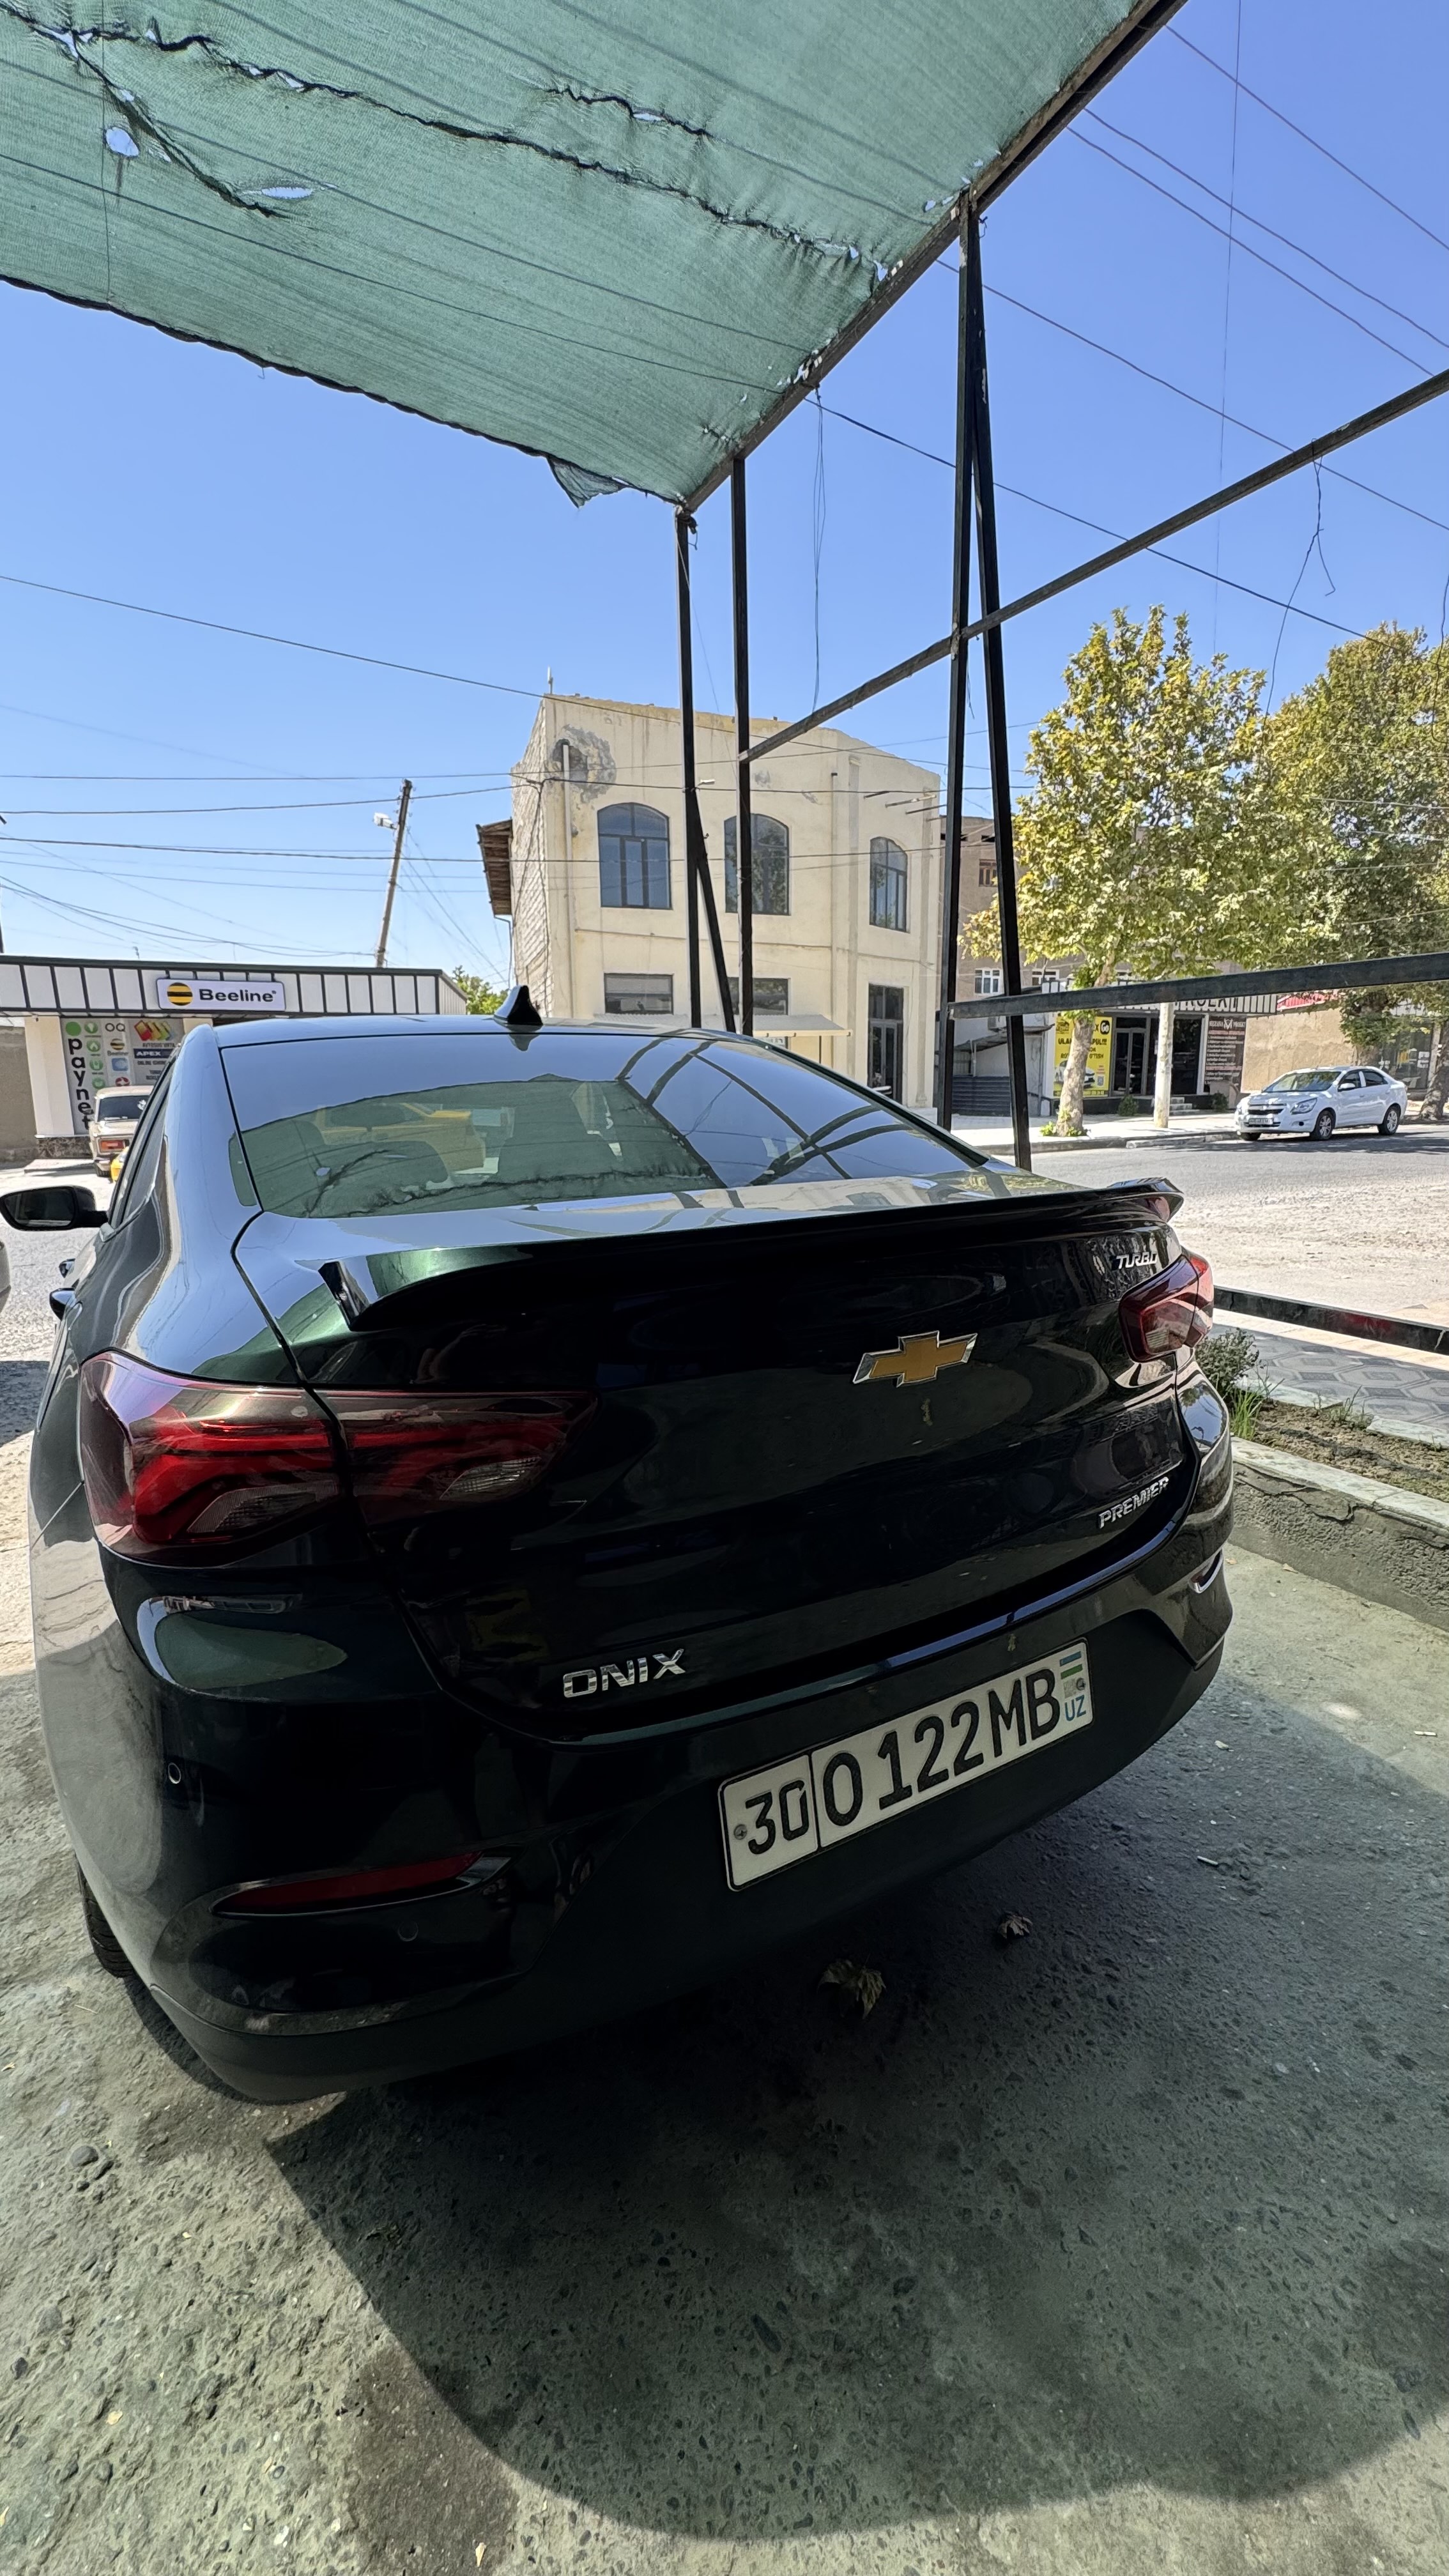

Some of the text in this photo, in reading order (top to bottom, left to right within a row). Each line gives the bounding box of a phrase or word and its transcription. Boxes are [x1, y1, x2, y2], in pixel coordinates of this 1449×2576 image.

[199, 988, 273, 1002] Beeline
[105, 1022, 126, 1032] OQ
[68, 1038, 94, 1130] paynet
[1116, 1252, 1157, 1269] TURBO
[1099, 1476, 1169, 1529] PREMIER
[563, 1648, 686, 1698] ONIX
[1064, 1694, 1086, 1722] UZ
[744, 1779, 809, 1855] 30
